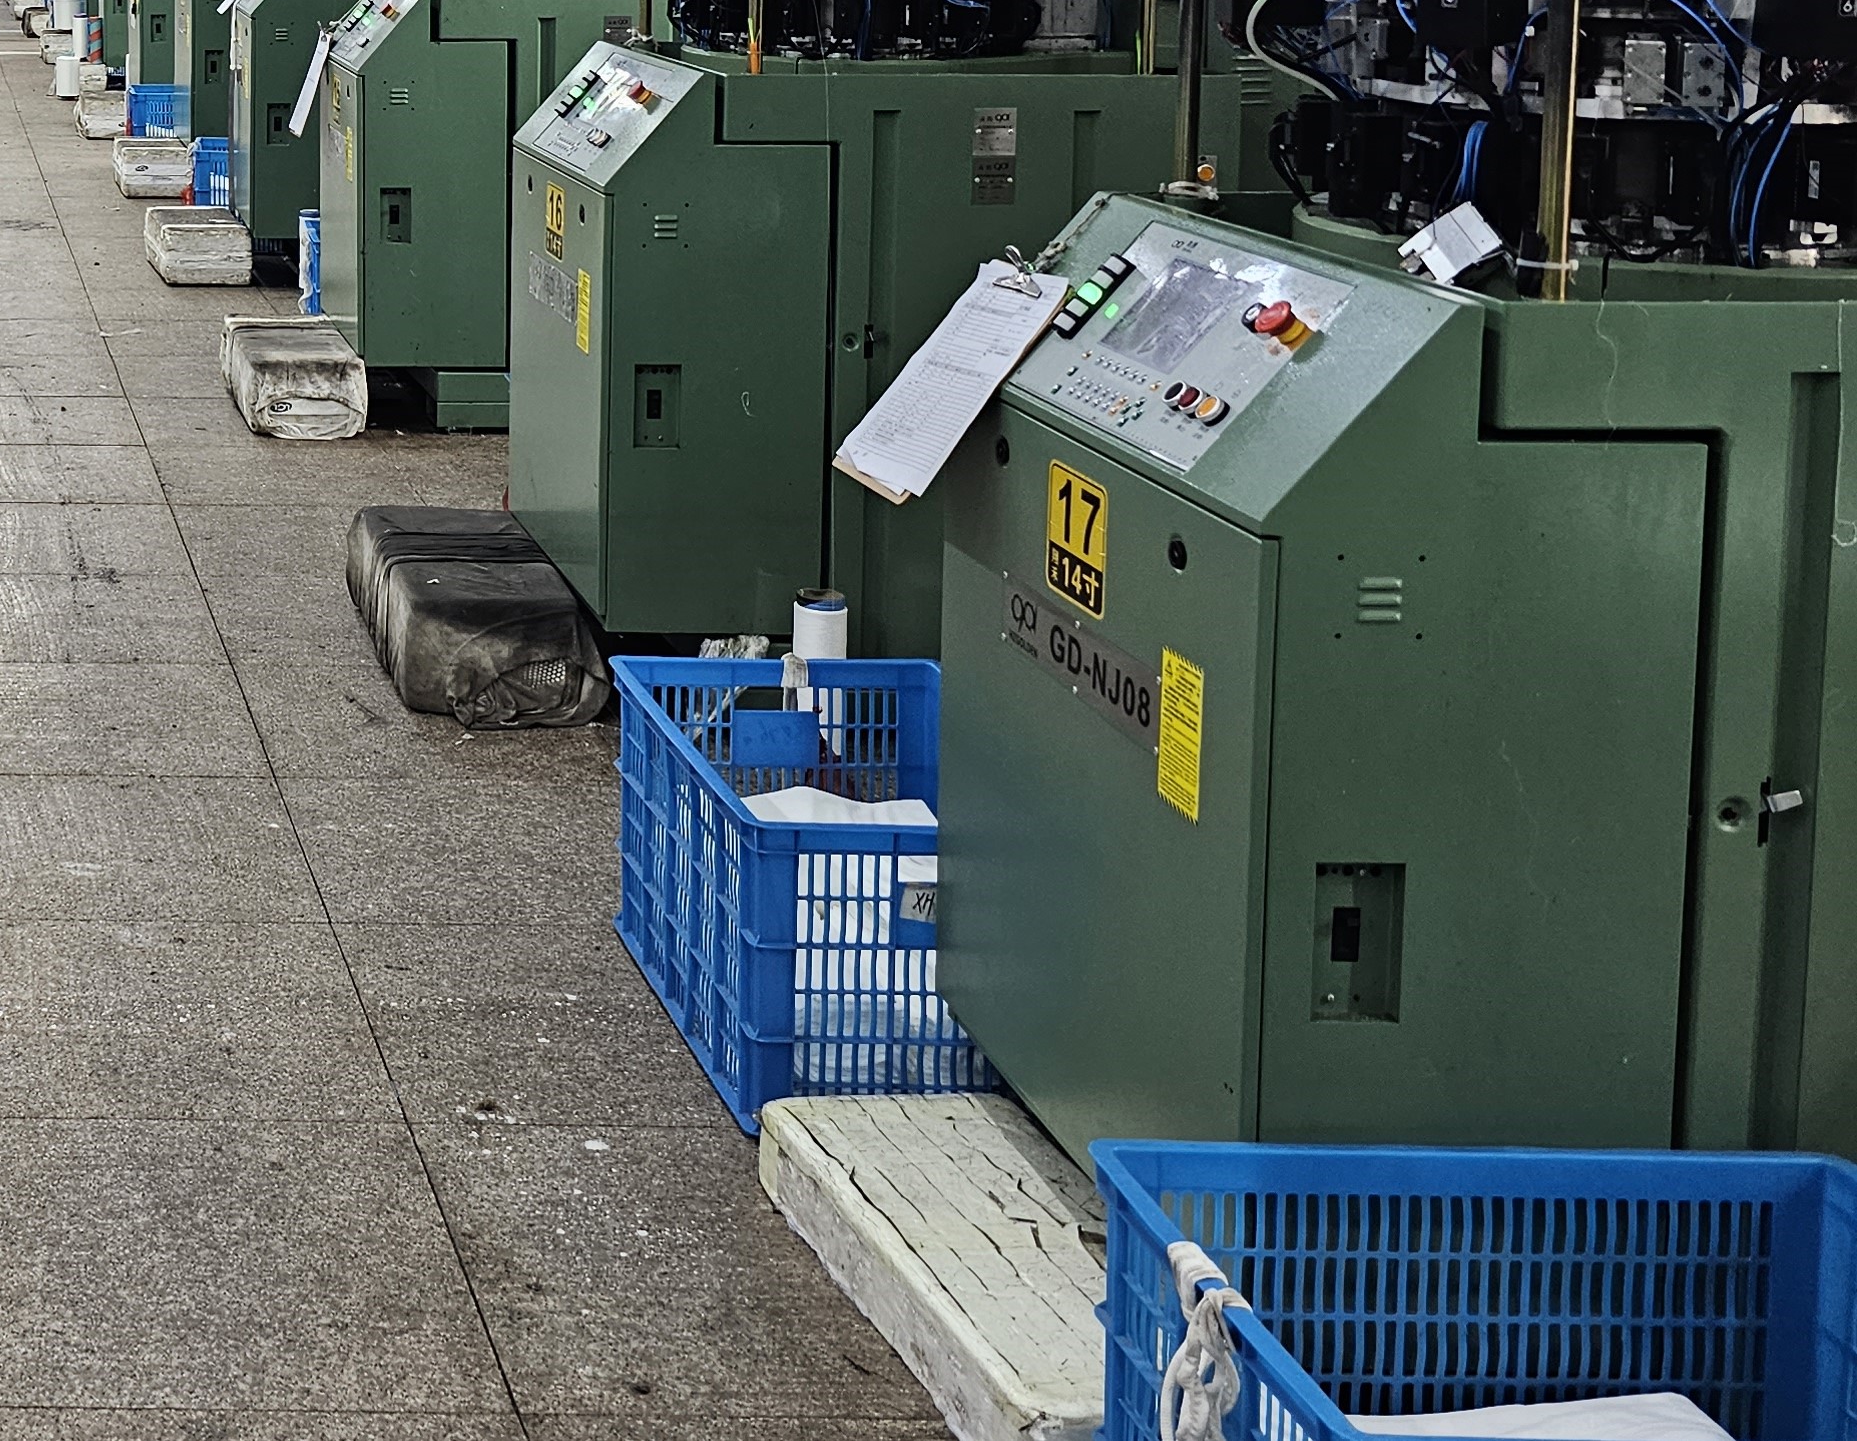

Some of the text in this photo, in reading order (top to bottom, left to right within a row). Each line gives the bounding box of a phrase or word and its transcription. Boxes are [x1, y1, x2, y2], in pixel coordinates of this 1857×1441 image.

[1843, 0, 1853, 13] 6
[549, 189, 562, 231] 16
[1058, 478, 1101, 556] 17
[1062, 557, 1100, 608] 14寸
[1049, 624, 1151, 728] GD-NJ08
